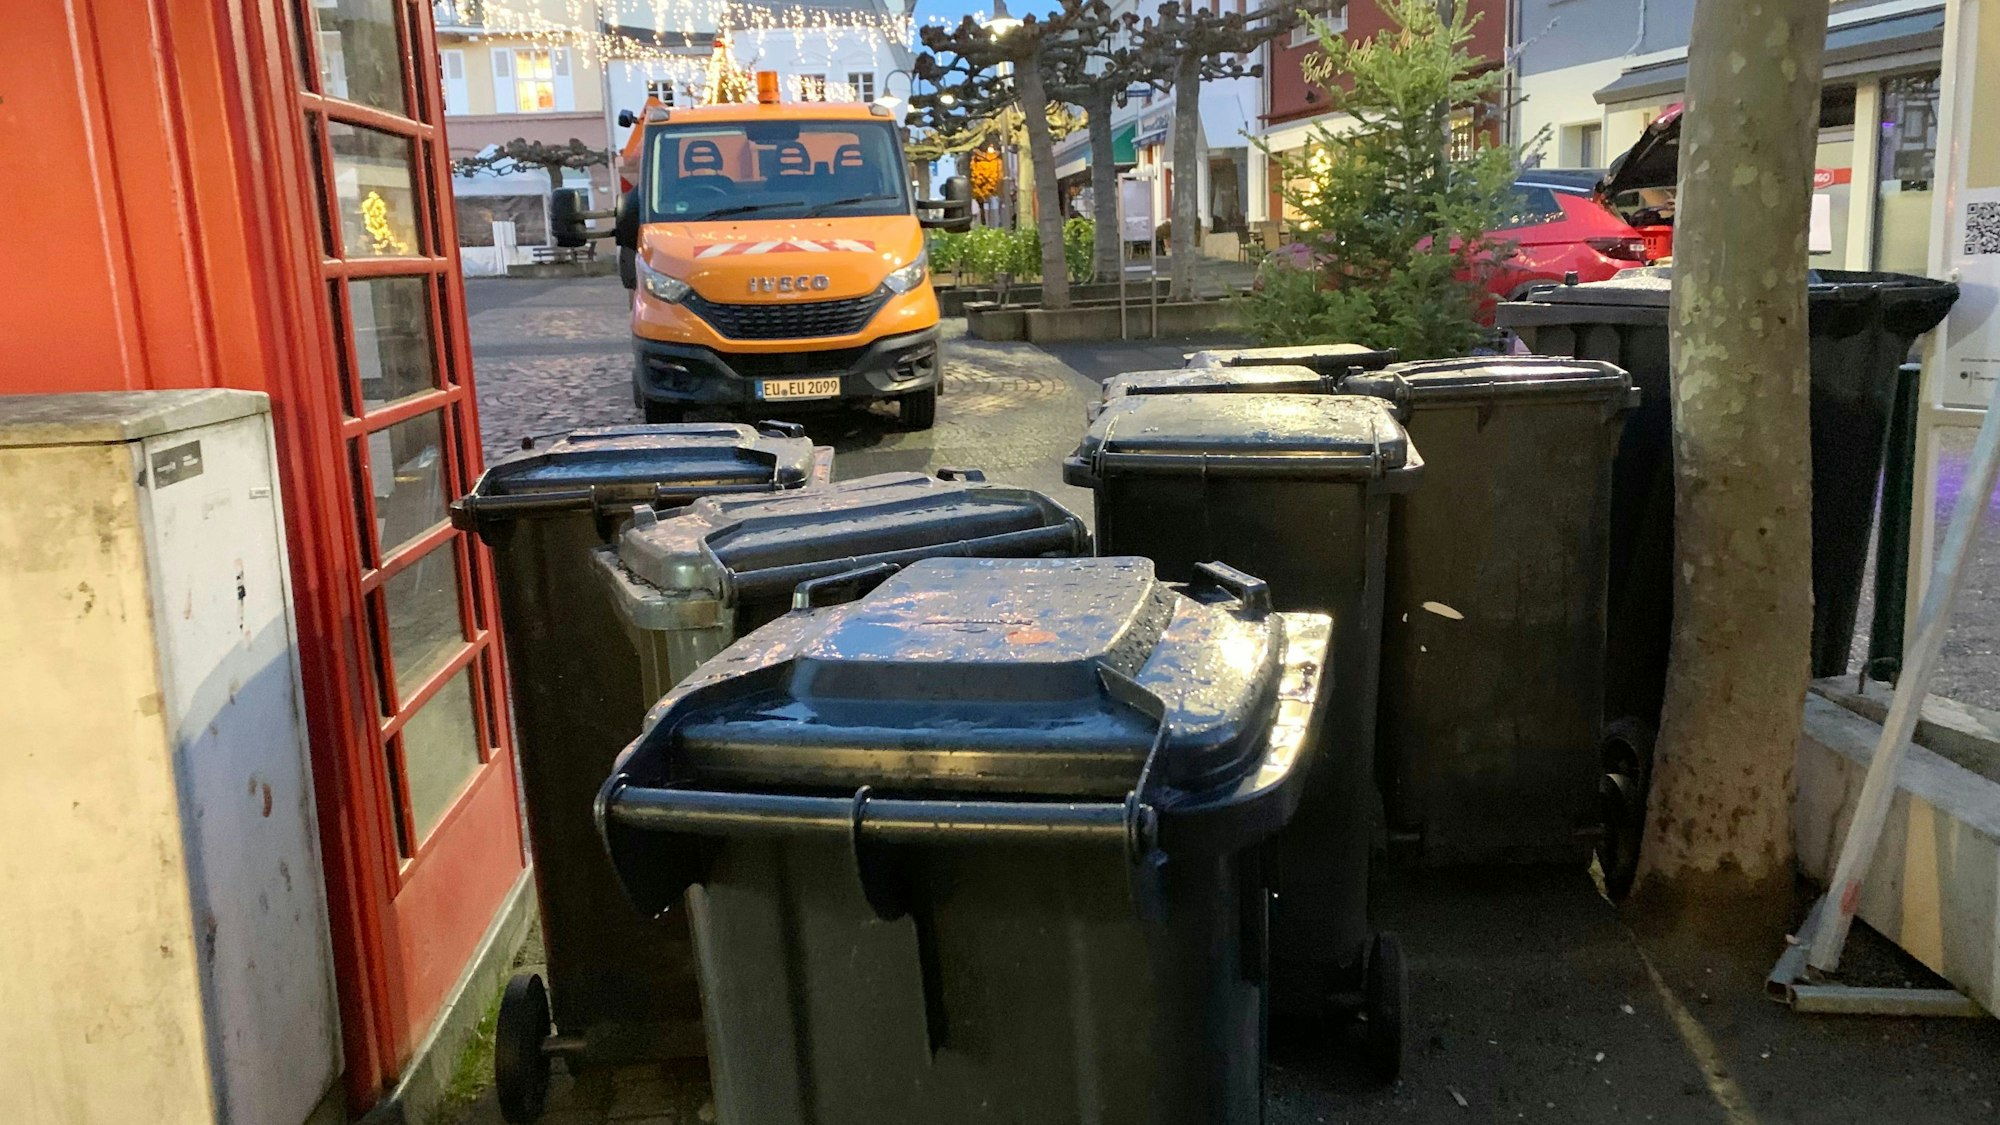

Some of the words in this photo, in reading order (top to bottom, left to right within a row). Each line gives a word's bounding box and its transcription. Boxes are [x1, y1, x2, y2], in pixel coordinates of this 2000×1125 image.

[750, 274, 830, 292] IVECO
[764, 383, 780, 396] EU
[789, 382, 804, 395] EU
[808, 380, 838, 394] 2099
